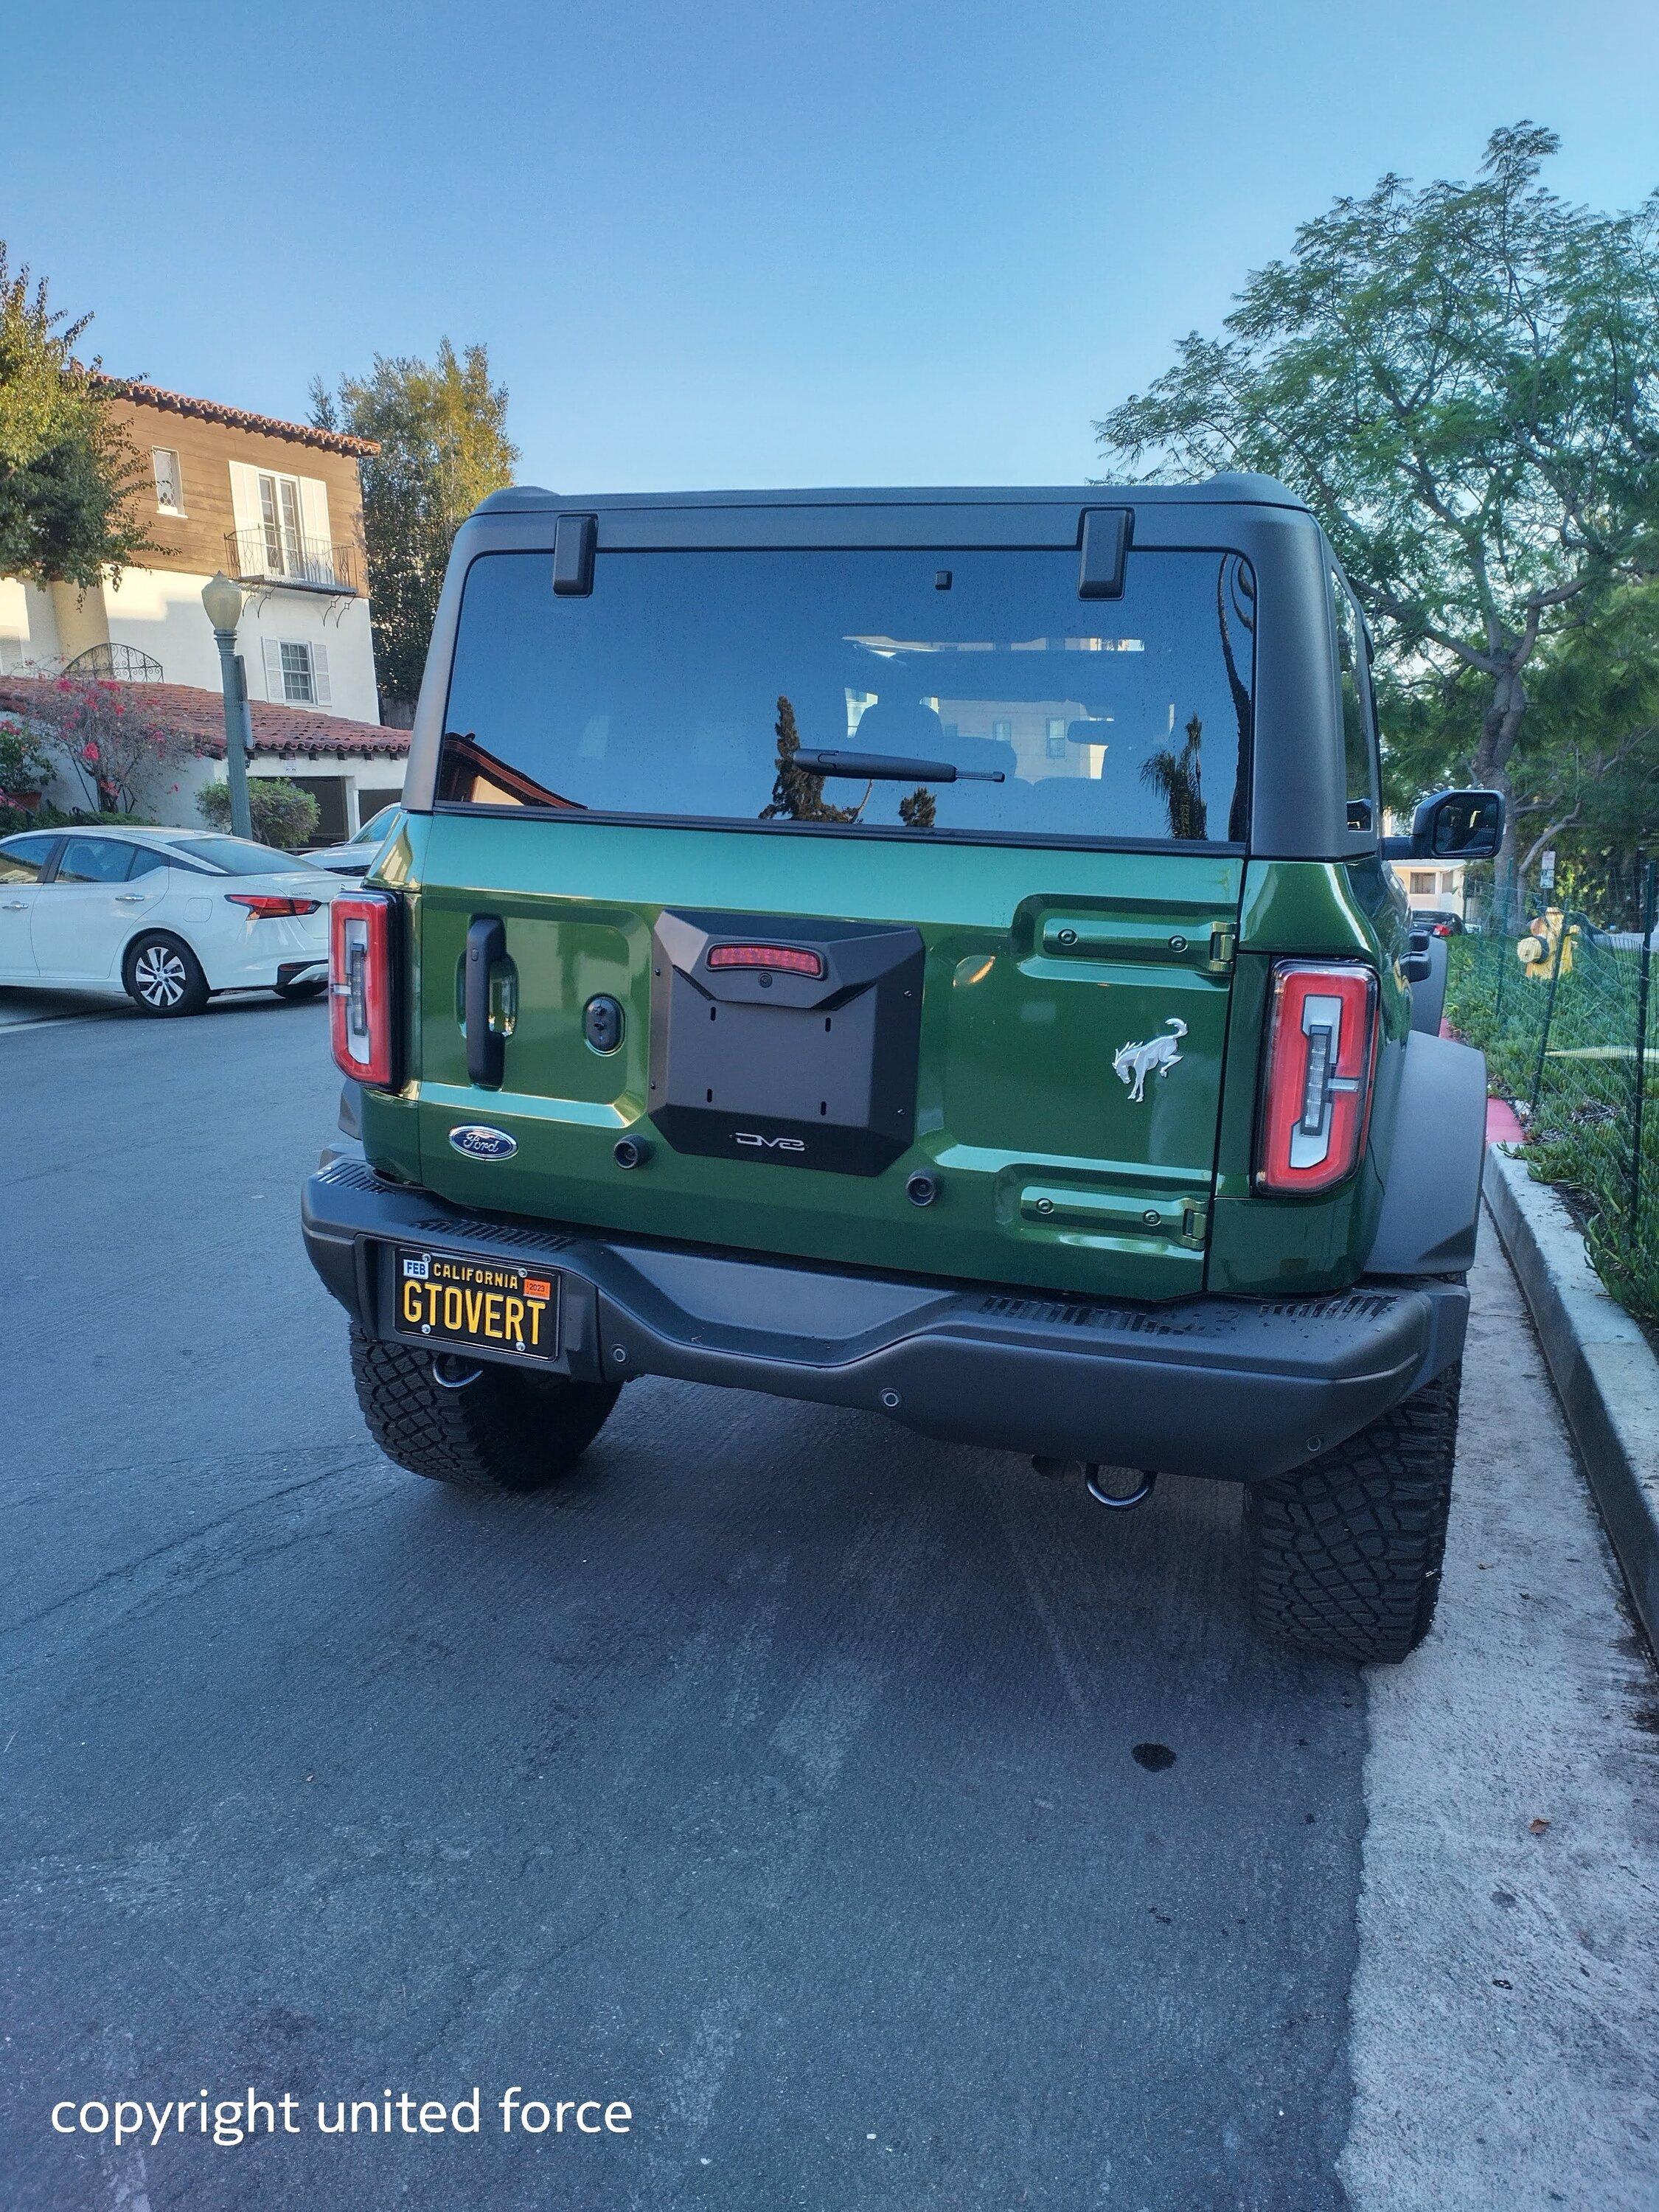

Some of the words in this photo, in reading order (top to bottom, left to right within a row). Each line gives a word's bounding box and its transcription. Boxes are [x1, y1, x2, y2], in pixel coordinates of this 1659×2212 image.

[462, 1132, 500, 1152] Ford
[407, 1262, 425, 1276] FEB
[433, 1262, 518, 1290] CALIFORNIA
[529, 1283, 545, 1292] 2023
[403, 1279, 546, 1345] GTOVERT
